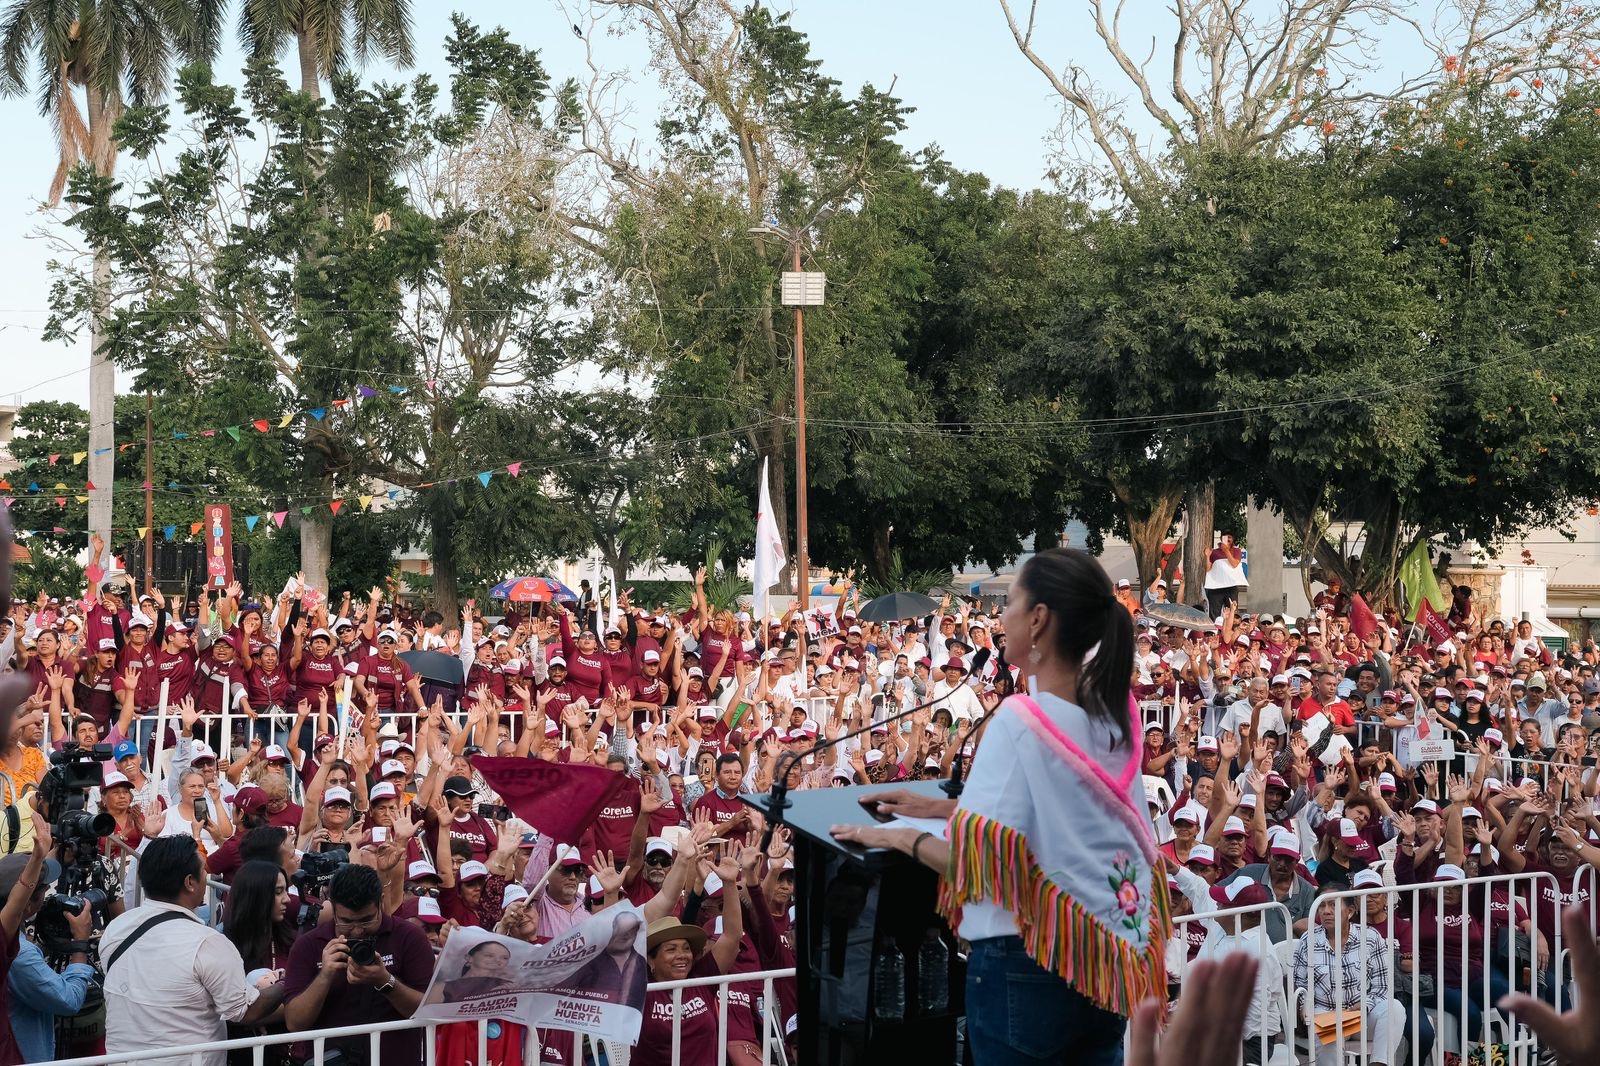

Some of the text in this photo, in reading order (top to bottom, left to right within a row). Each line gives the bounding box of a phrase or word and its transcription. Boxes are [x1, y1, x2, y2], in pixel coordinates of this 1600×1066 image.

[601, 805, 633, 816] orena
[551, 938, 585, 957] VOTA
[584, 991, 609, 1000] PUEBLO
[458, 1002, 518, 1013] SHEINBAUM
[460, 996, 518, 1010] CLAUDIA
[557, 999, 603, 1015] MANUEL
[554, 1008, 601, 1024] HUERTA
